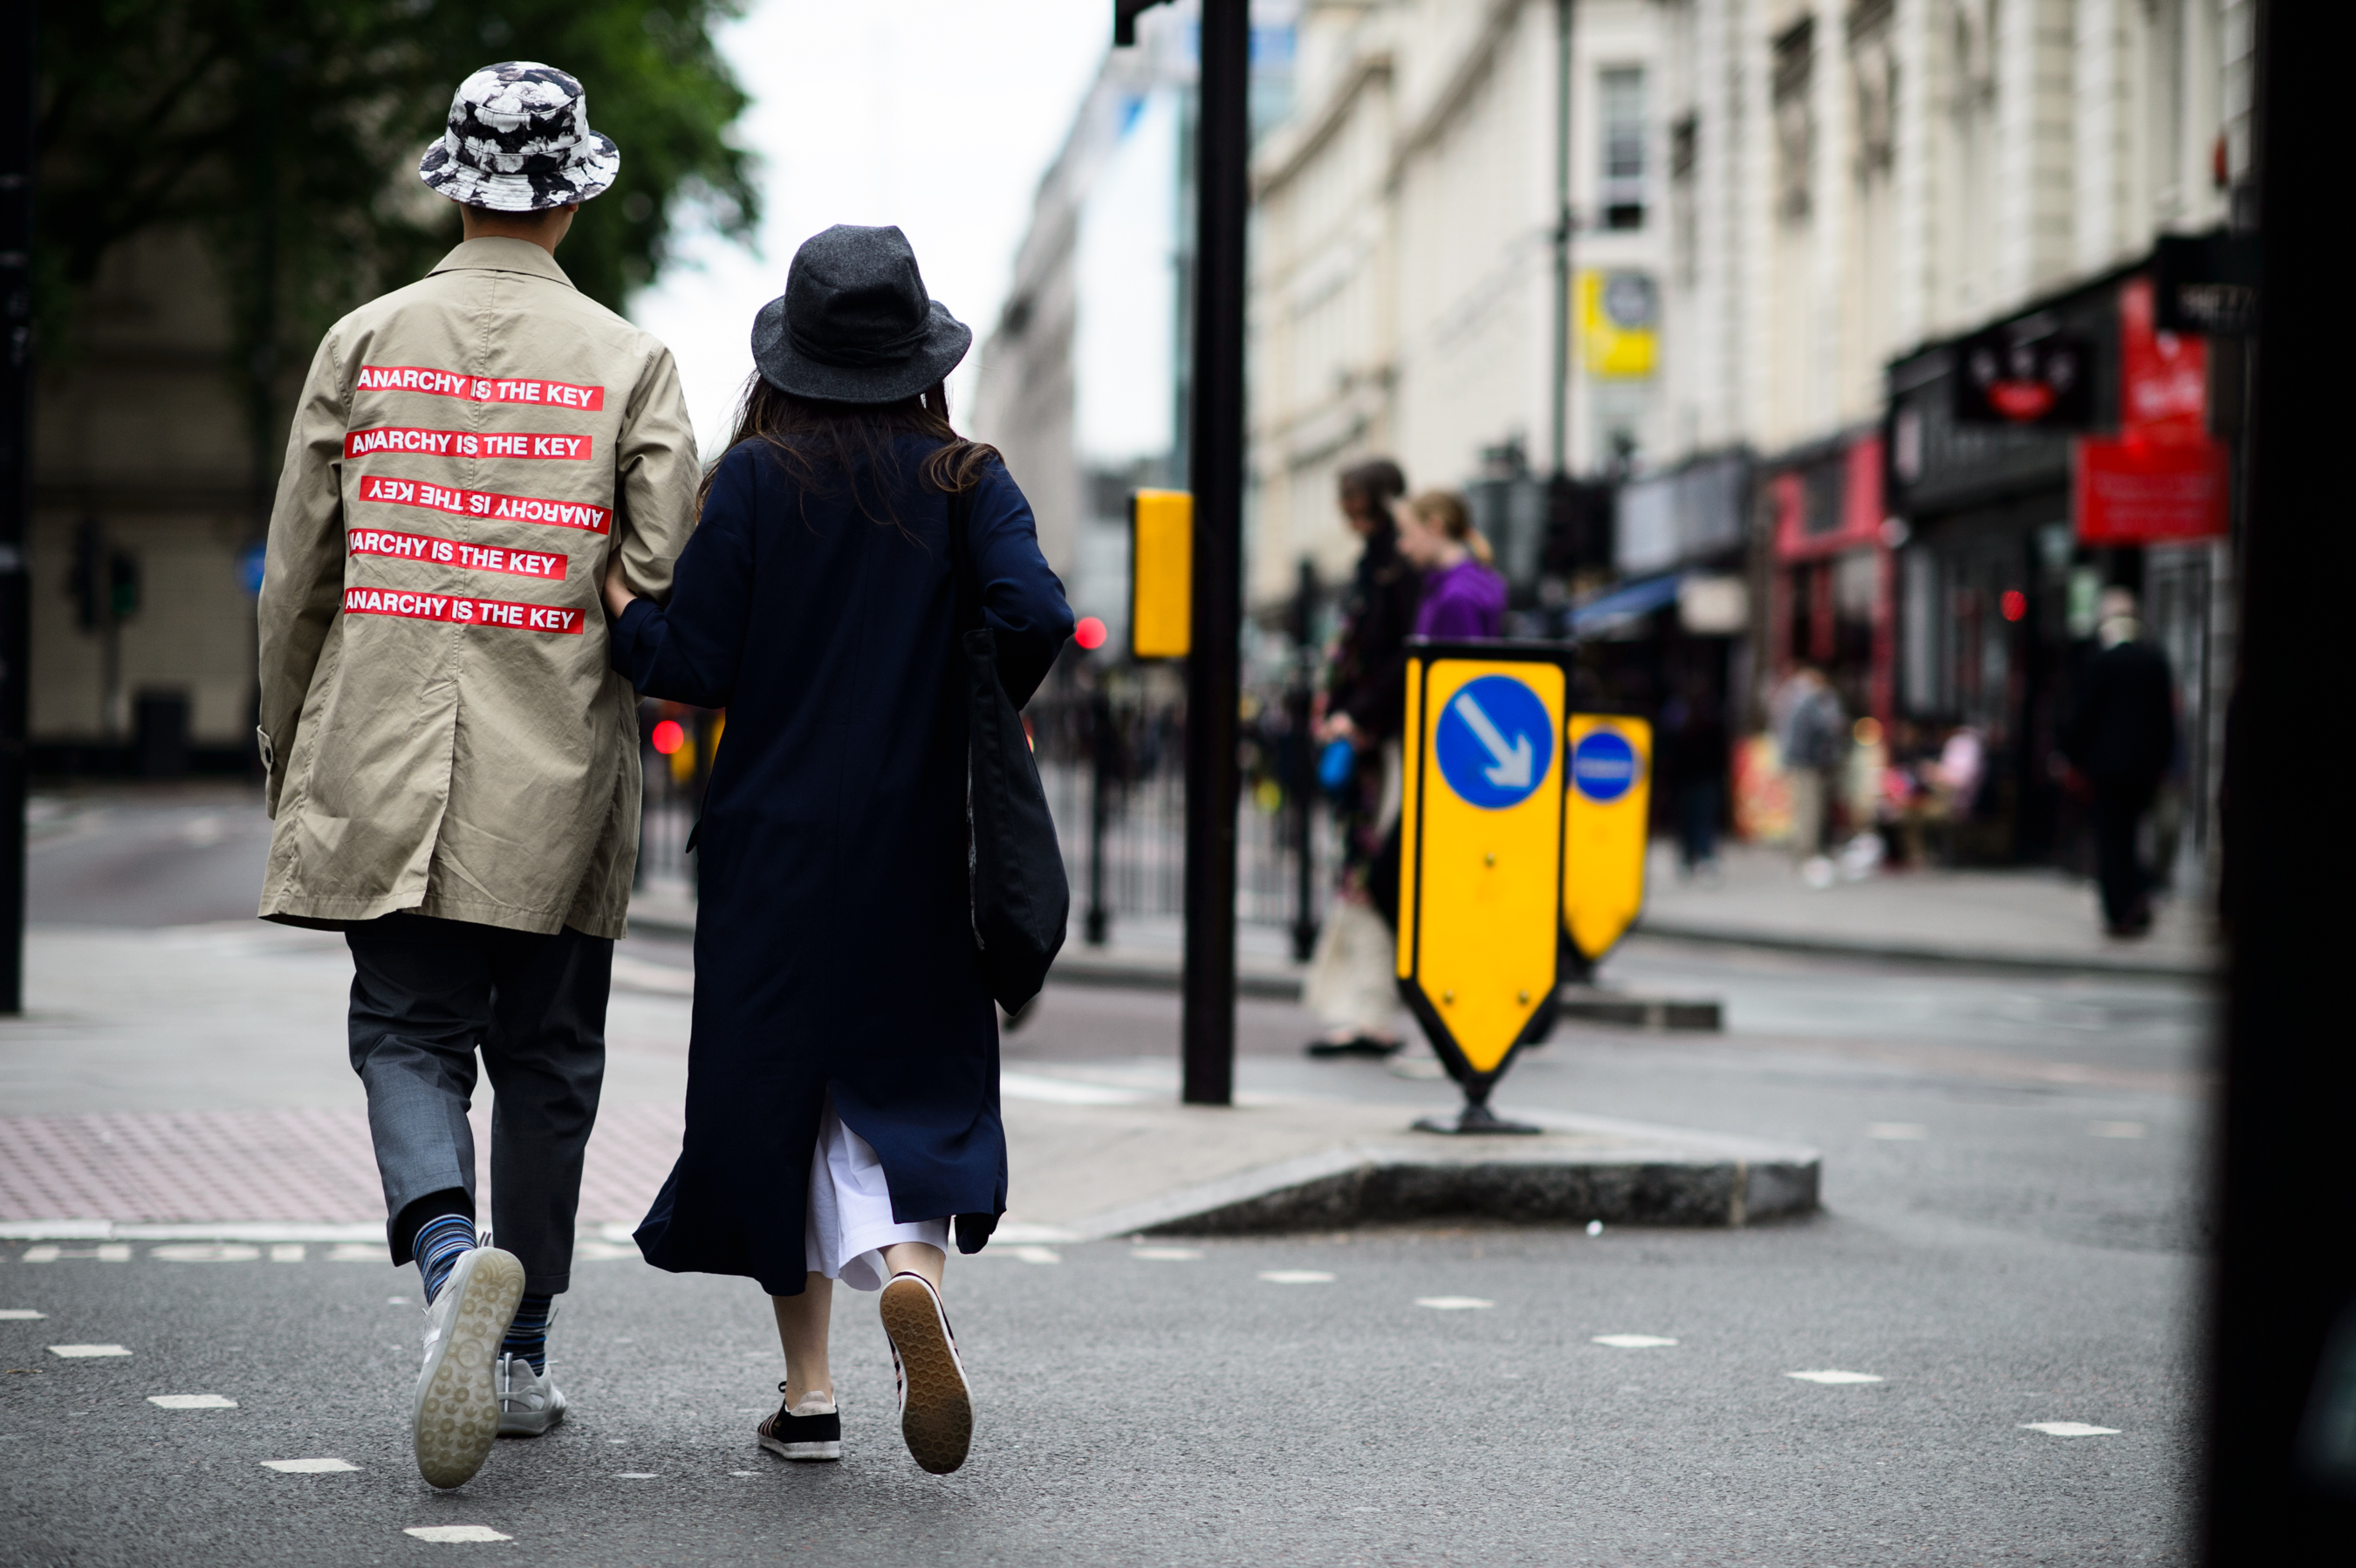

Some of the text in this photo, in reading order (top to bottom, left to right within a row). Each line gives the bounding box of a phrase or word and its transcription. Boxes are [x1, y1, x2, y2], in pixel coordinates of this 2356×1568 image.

[358, 368, 593, 407] ANARCHY IS THE KEY
[352, 430, 581, 456] ANARCHY IS THE KEY
[368, 480, 604, 528] ANARCHY IS THE KEY
[349, 531, 557, 575] NARCHY IS THE KEY
[345, 591, 575, 629] ANARCHY IS THE KEY
